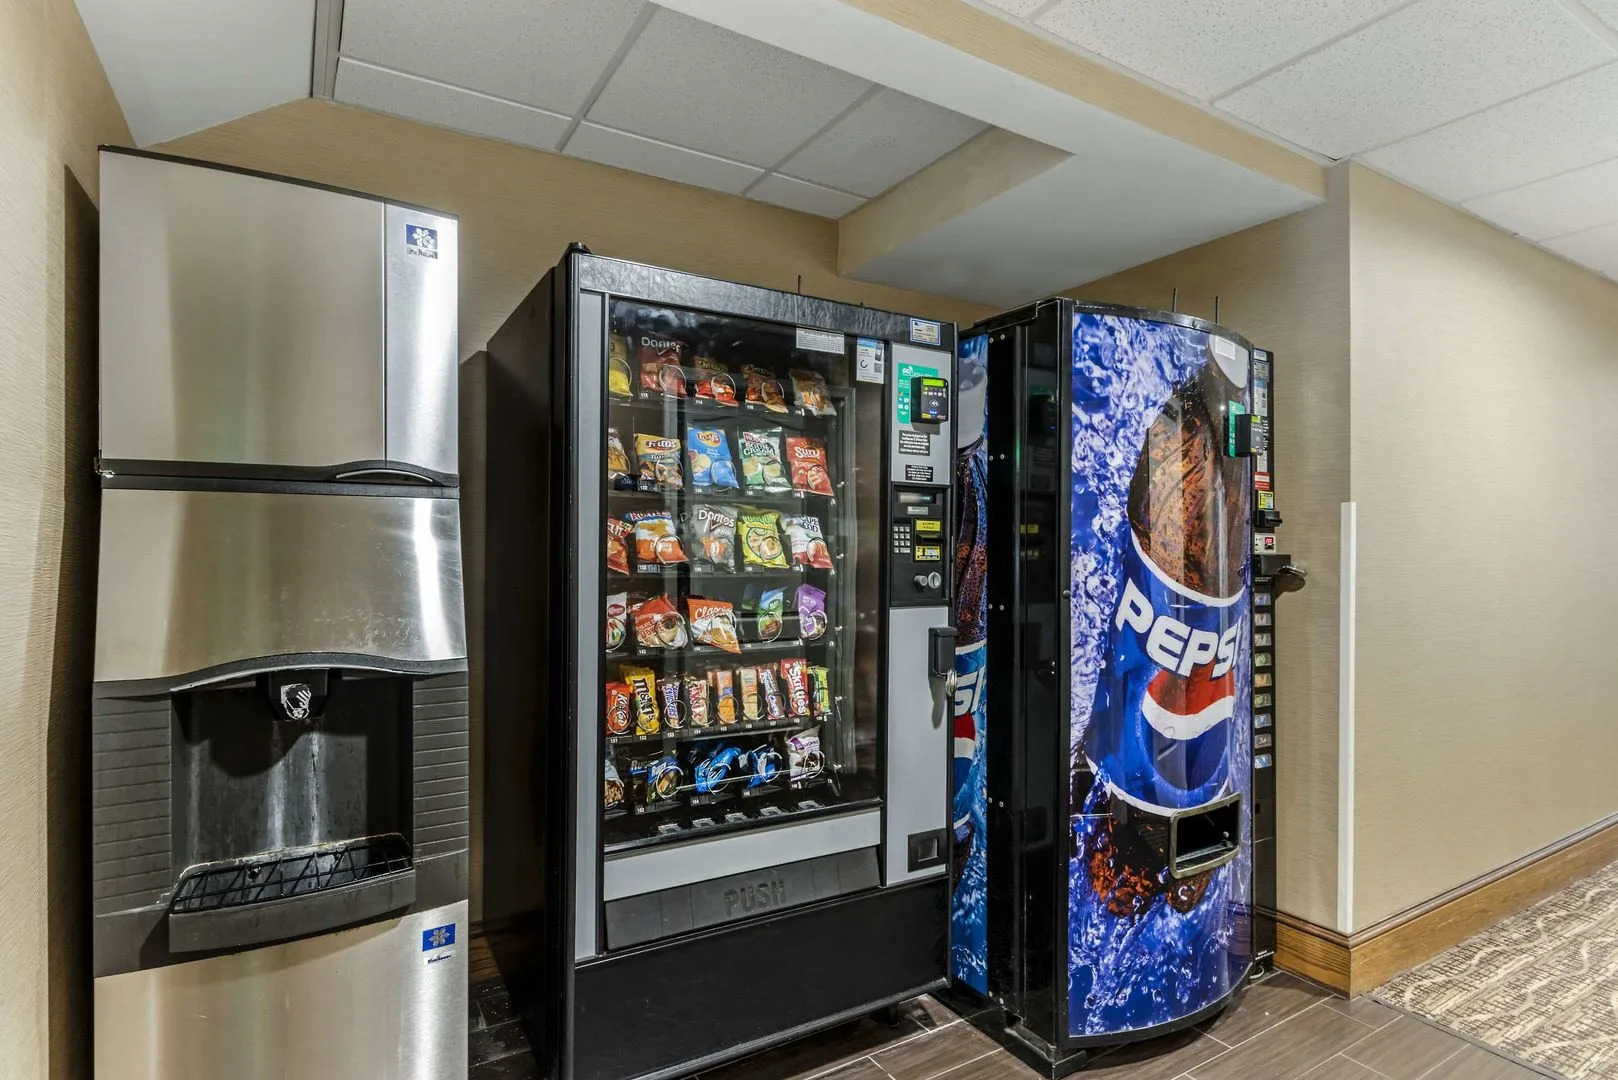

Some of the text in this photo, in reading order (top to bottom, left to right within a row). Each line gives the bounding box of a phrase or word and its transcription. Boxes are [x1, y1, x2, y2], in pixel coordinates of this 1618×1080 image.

[698, 509, 735, 527] Doritos
[1115, 577, 1242, 677] PEPSI
[724, 879, 787, 917] PUSH
